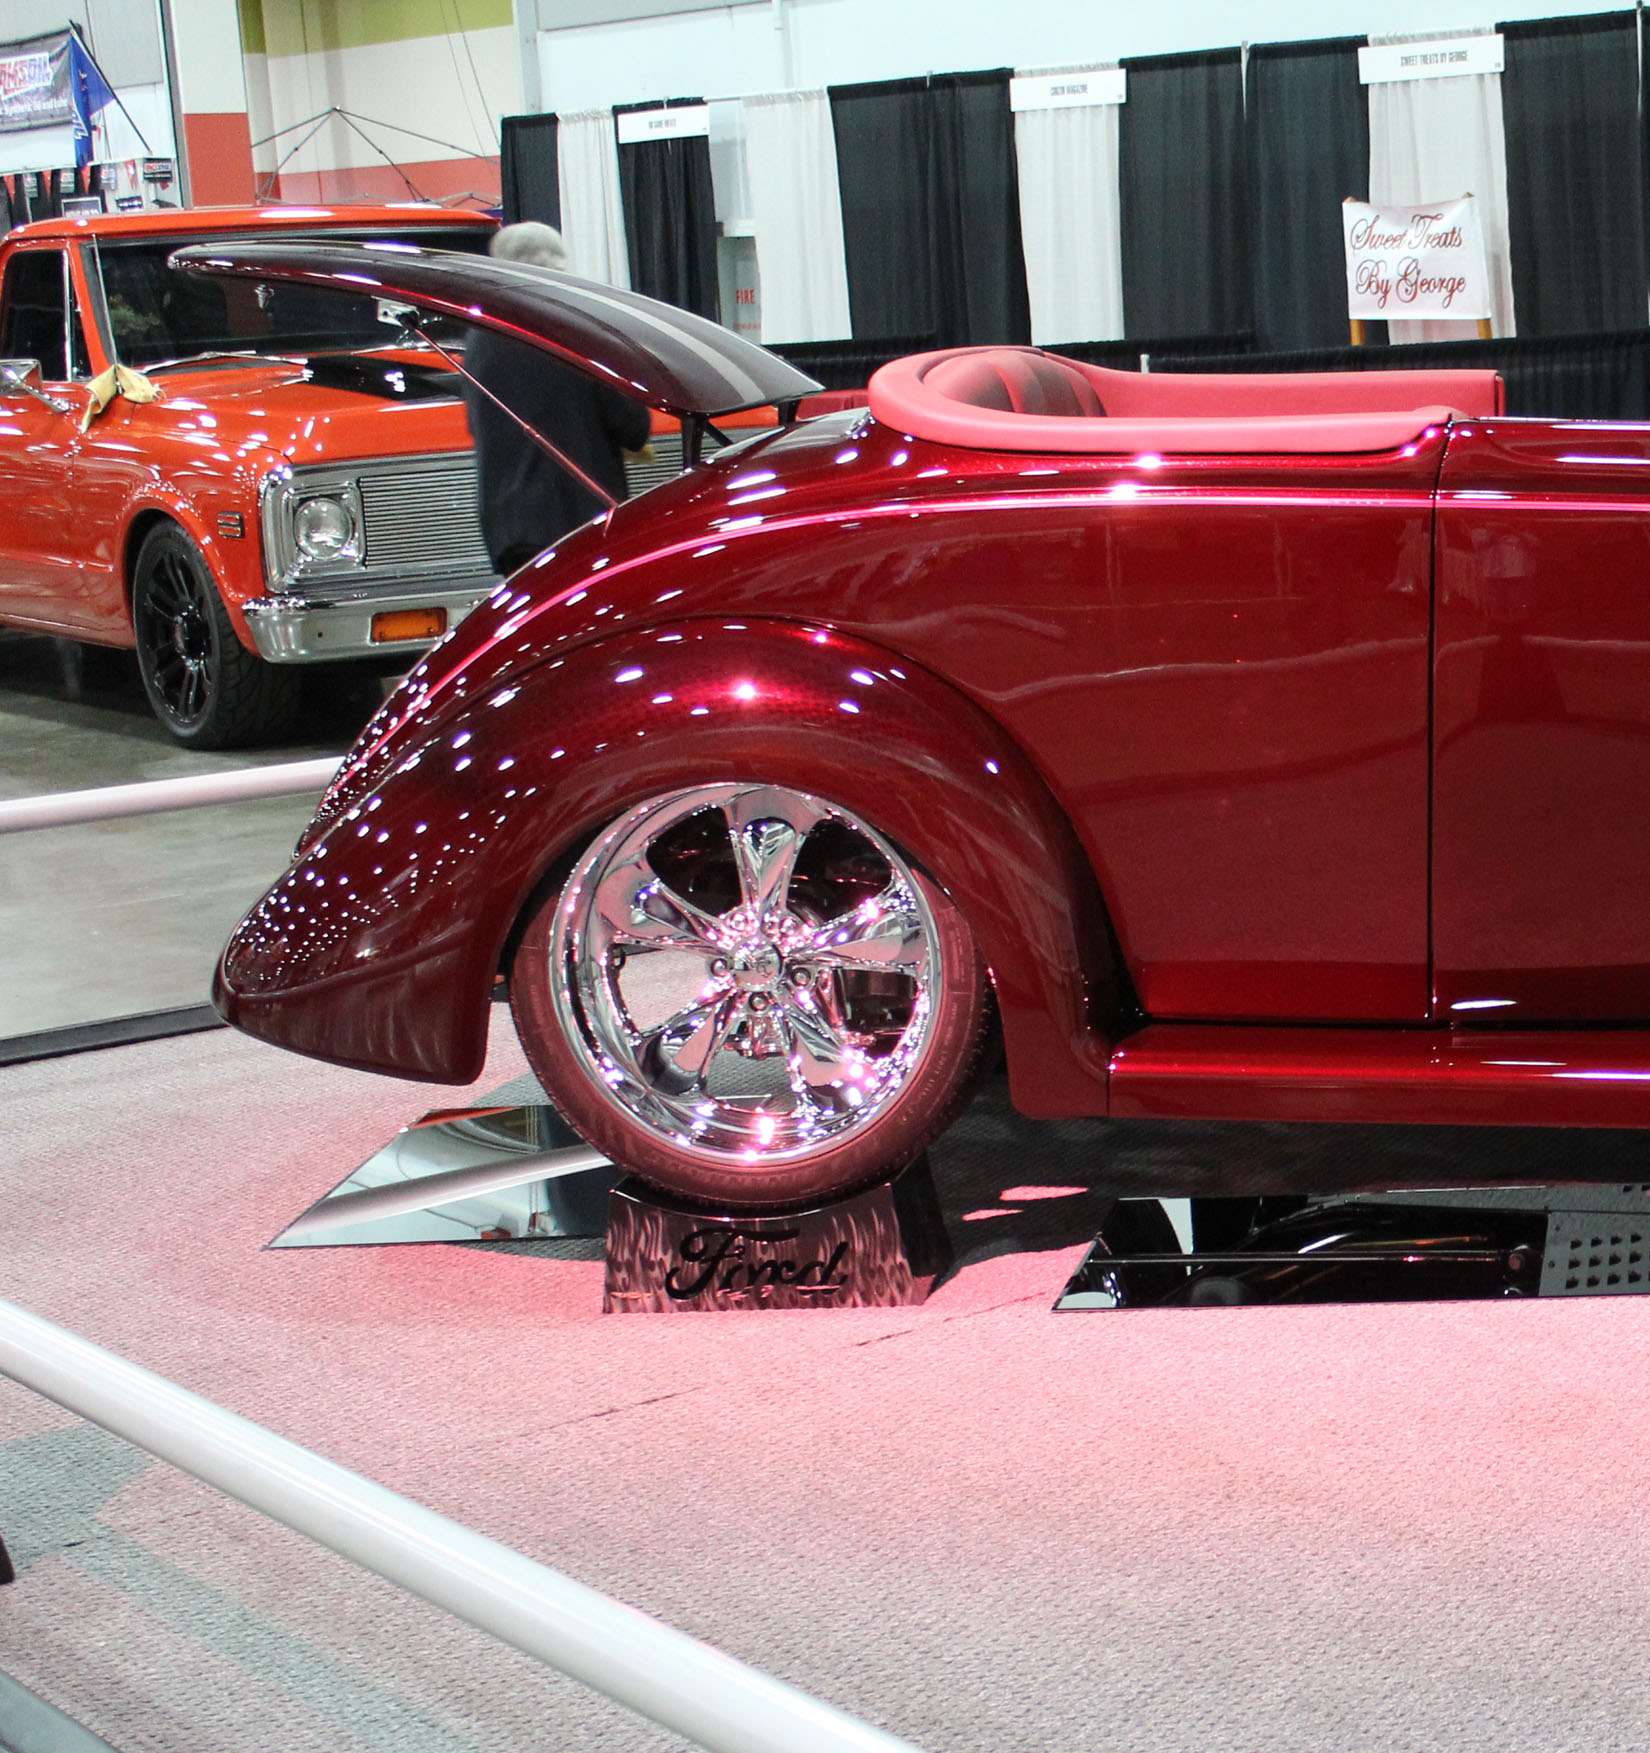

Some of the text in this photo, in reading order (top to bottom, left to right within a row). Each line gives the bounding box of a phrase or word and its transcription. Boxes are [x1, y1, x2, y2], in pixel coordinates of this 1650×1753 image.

[1400, 50, 1468, 67] SWEET TREATS BY GEORGE
[1350, 212, 1463, 250] Sweet Treats
[735, 288, 756, 304] FIRE
[1355, 256, 1467, 310] By George
[665, 1227, 850, 1300] Ford
